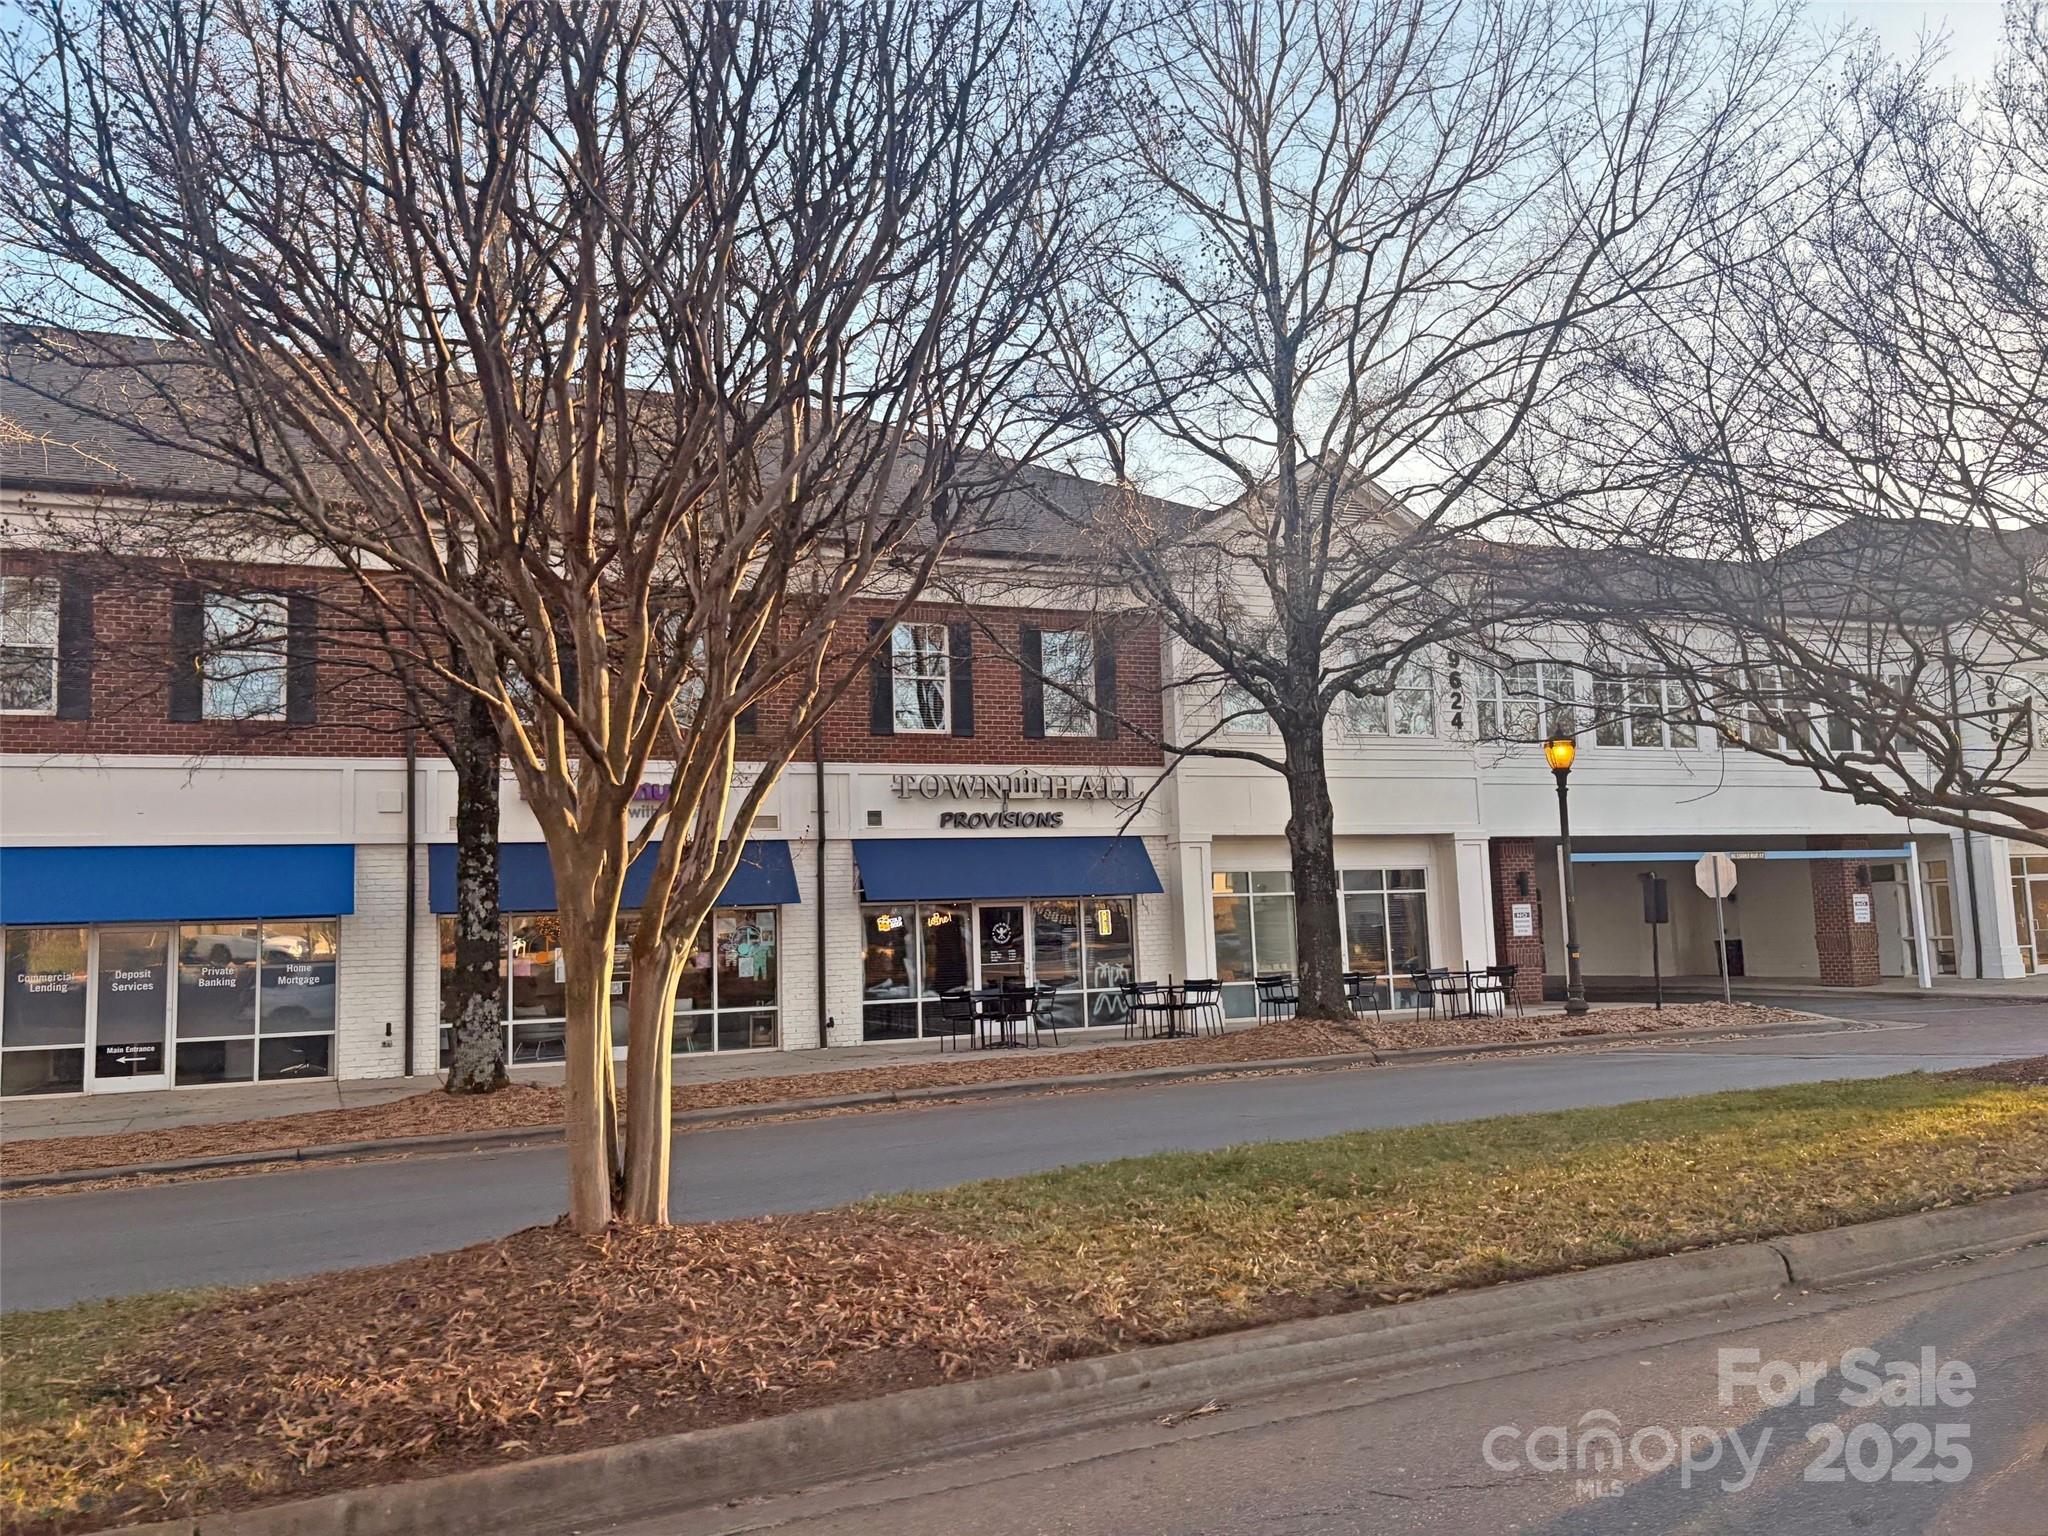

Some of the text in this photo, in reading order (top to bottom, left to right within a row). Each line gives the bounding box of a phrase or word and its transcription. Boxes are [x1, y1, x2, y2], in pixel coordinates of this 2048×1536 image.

[892, 774, 1143, 800] TOWN HALL
[940, 811, 1063, 829] PROVISIONS
[202, 966, 235, 976] Private
[286, 964, 312, 973] Home
[17, 972, 75, 983] Commercial
[115, 970, 151, 980] Deposit
[112, 982, 154, 991] Services
[199, 978, 236, 989] Banking
[278, 975, 320, 987] Mortgage
[30, 982, 67, 993] Lending
